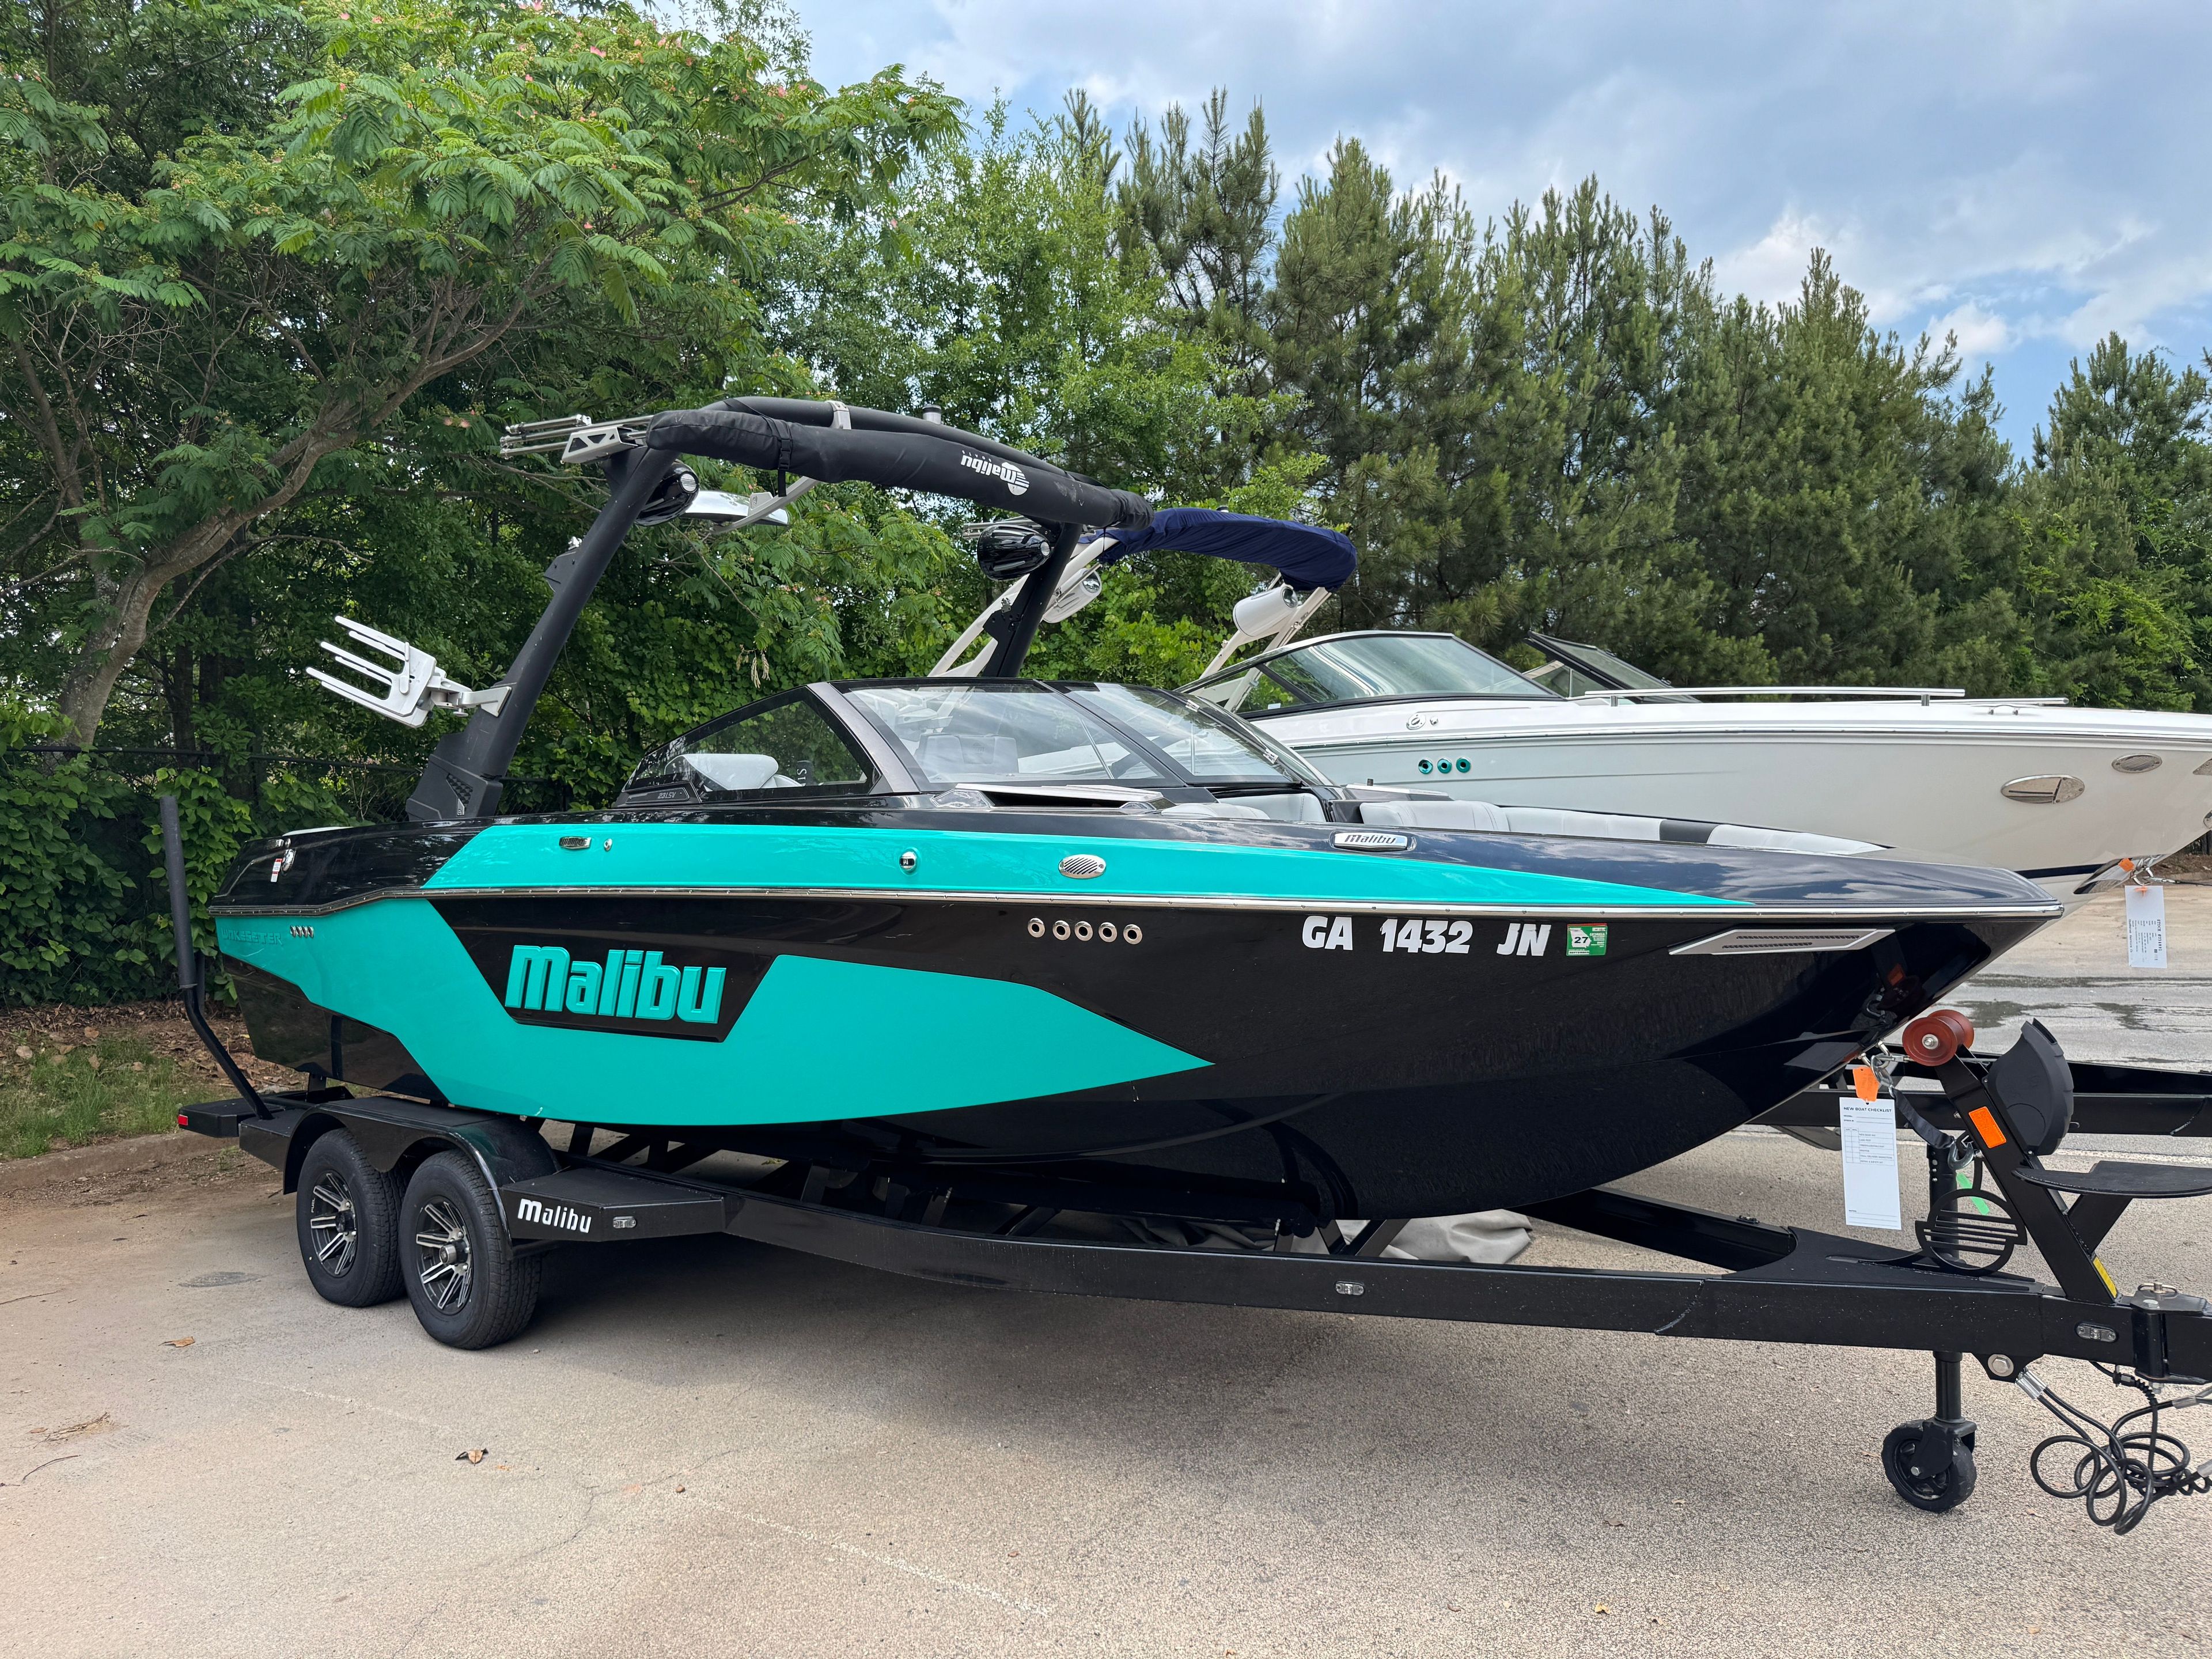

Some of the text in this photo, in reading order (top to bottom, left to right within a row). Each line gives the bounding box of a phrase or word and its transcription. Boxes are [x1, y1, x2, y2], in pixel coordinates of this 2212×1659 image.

[960, 454, 1017, 483] Malibu
[1344, 834, 1396, 844] Malibu
[1302, 915, 1552, 957] GA 1432 JN
[505, 944, 727, 1024] Malibu
[517, 1198, 592, 1233] Malibu
